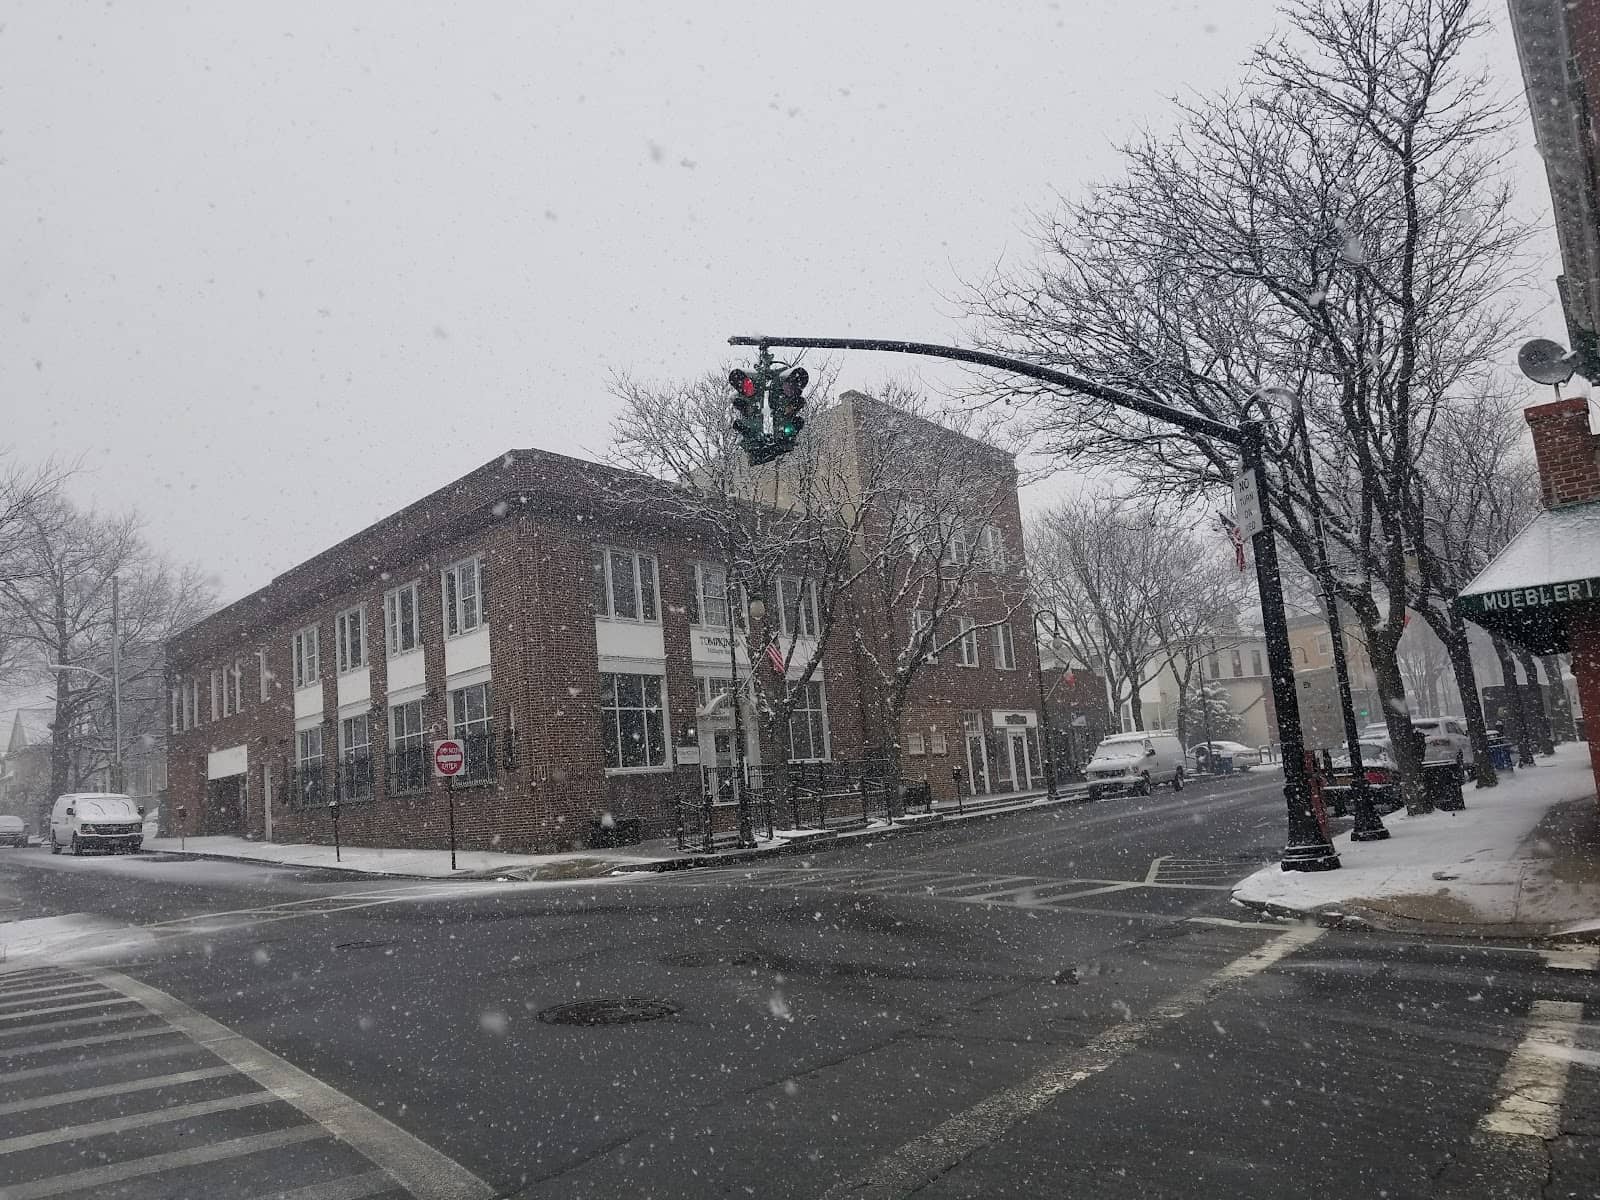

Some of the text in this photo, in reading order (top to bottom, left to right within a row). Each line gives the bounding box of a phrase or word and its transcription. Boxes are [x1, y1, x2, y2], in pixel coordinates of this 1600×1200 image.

[1239, 479, 1250, 492] NO
[1240, 493, 1254, 506] TURN
[1245, 508, 1254, 519] ON
[1482, 579, 1600, 612] MUEBLERI
[441, 762, 458, 770] ENTER
